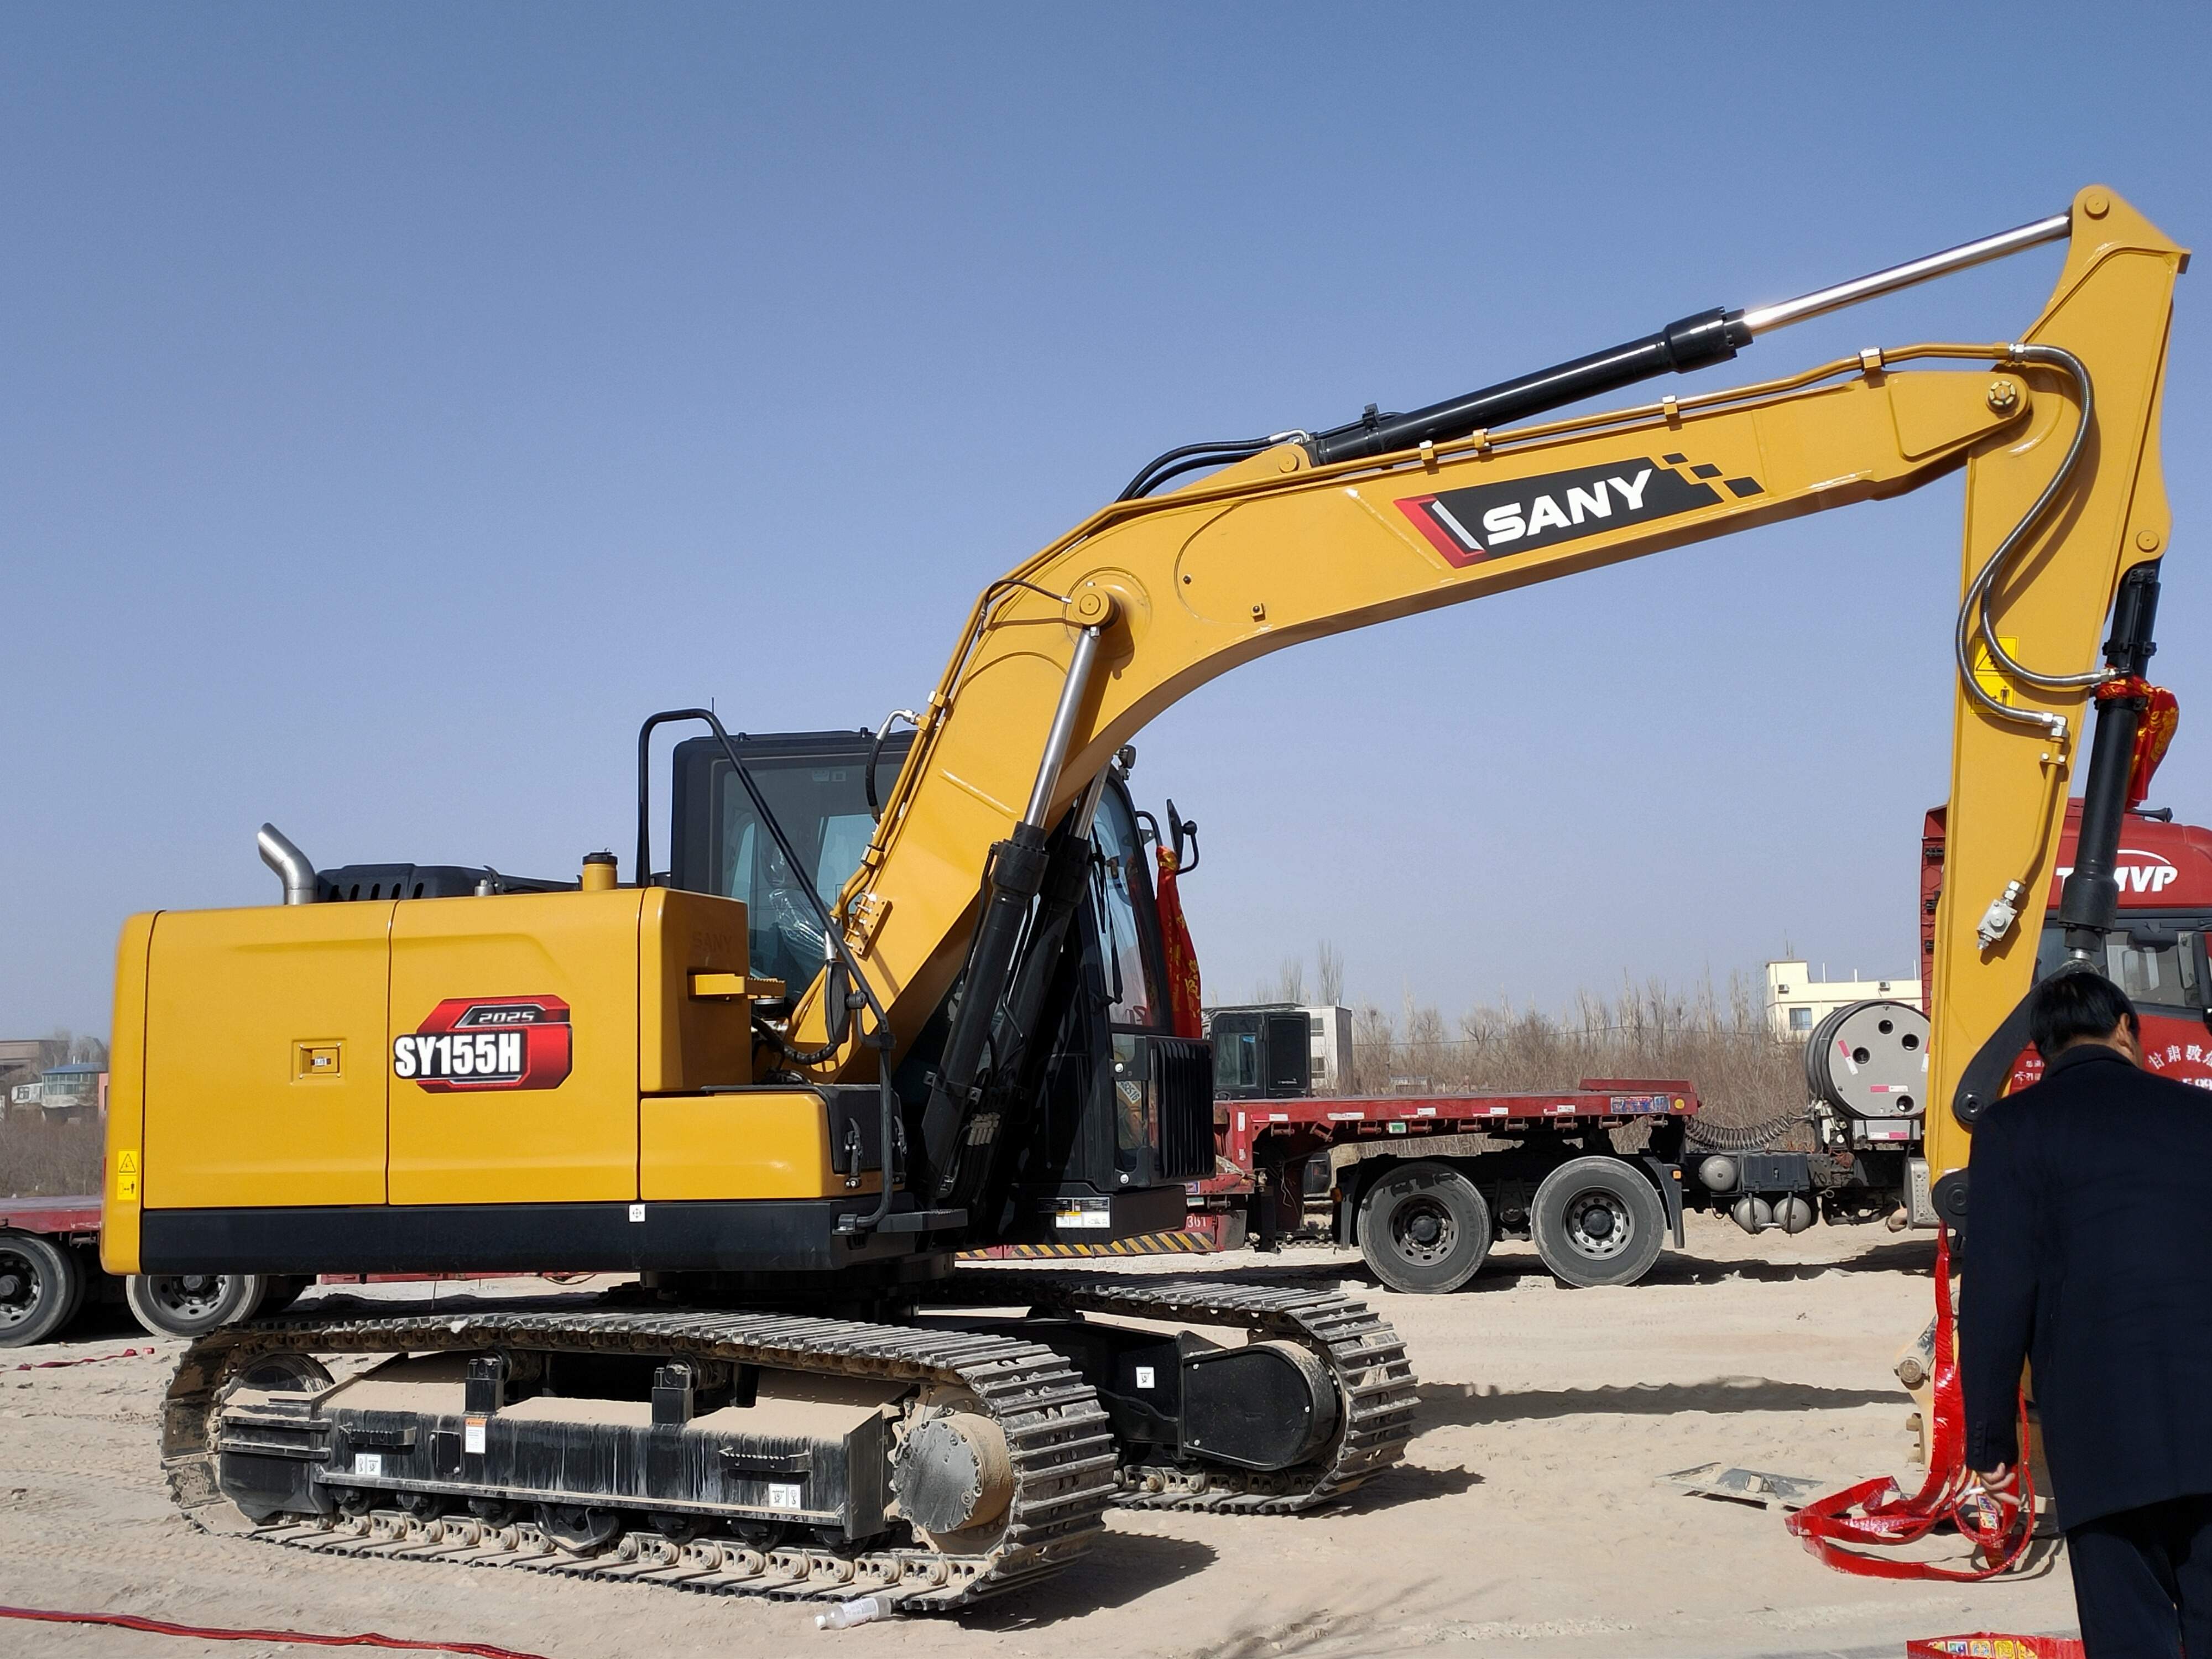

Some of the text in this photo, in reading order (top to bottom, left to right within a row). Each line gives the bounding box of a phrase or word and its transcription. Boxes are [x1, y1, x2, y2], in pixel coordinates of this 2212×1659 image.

[1483, 468, 1653, 546] SANY
[478, 1011, 535, 1023] 2025
[394, 1032, 520, 1077] SY155H
